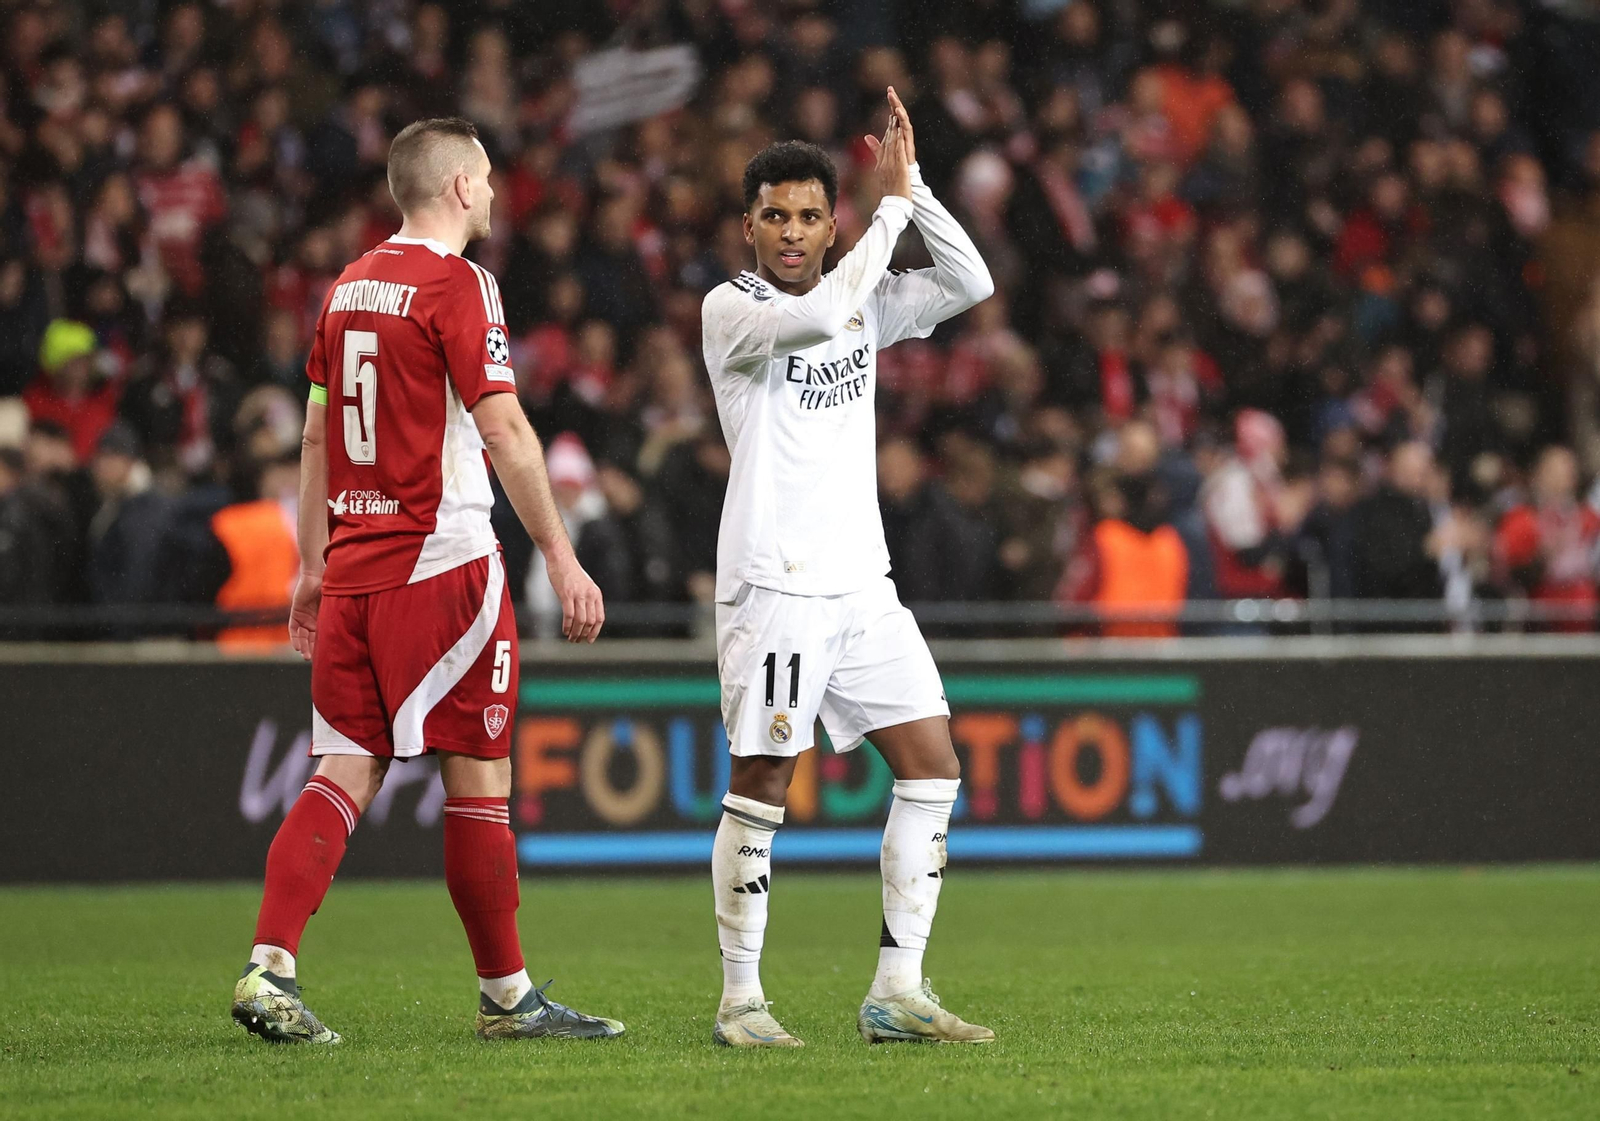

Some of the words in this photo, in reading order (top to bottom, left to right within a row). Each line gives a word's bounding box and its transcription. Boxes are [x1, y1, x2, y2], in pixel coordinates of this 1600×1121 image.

[343, 330, 378, 466] 5
[800, 389, 827, 410] FLY
[349, 490, 381, 500] FONDS
[349, 499, 364, 515] LE
[491, 640, 511, 694] 5
[762, 652, 801, 708] 11
